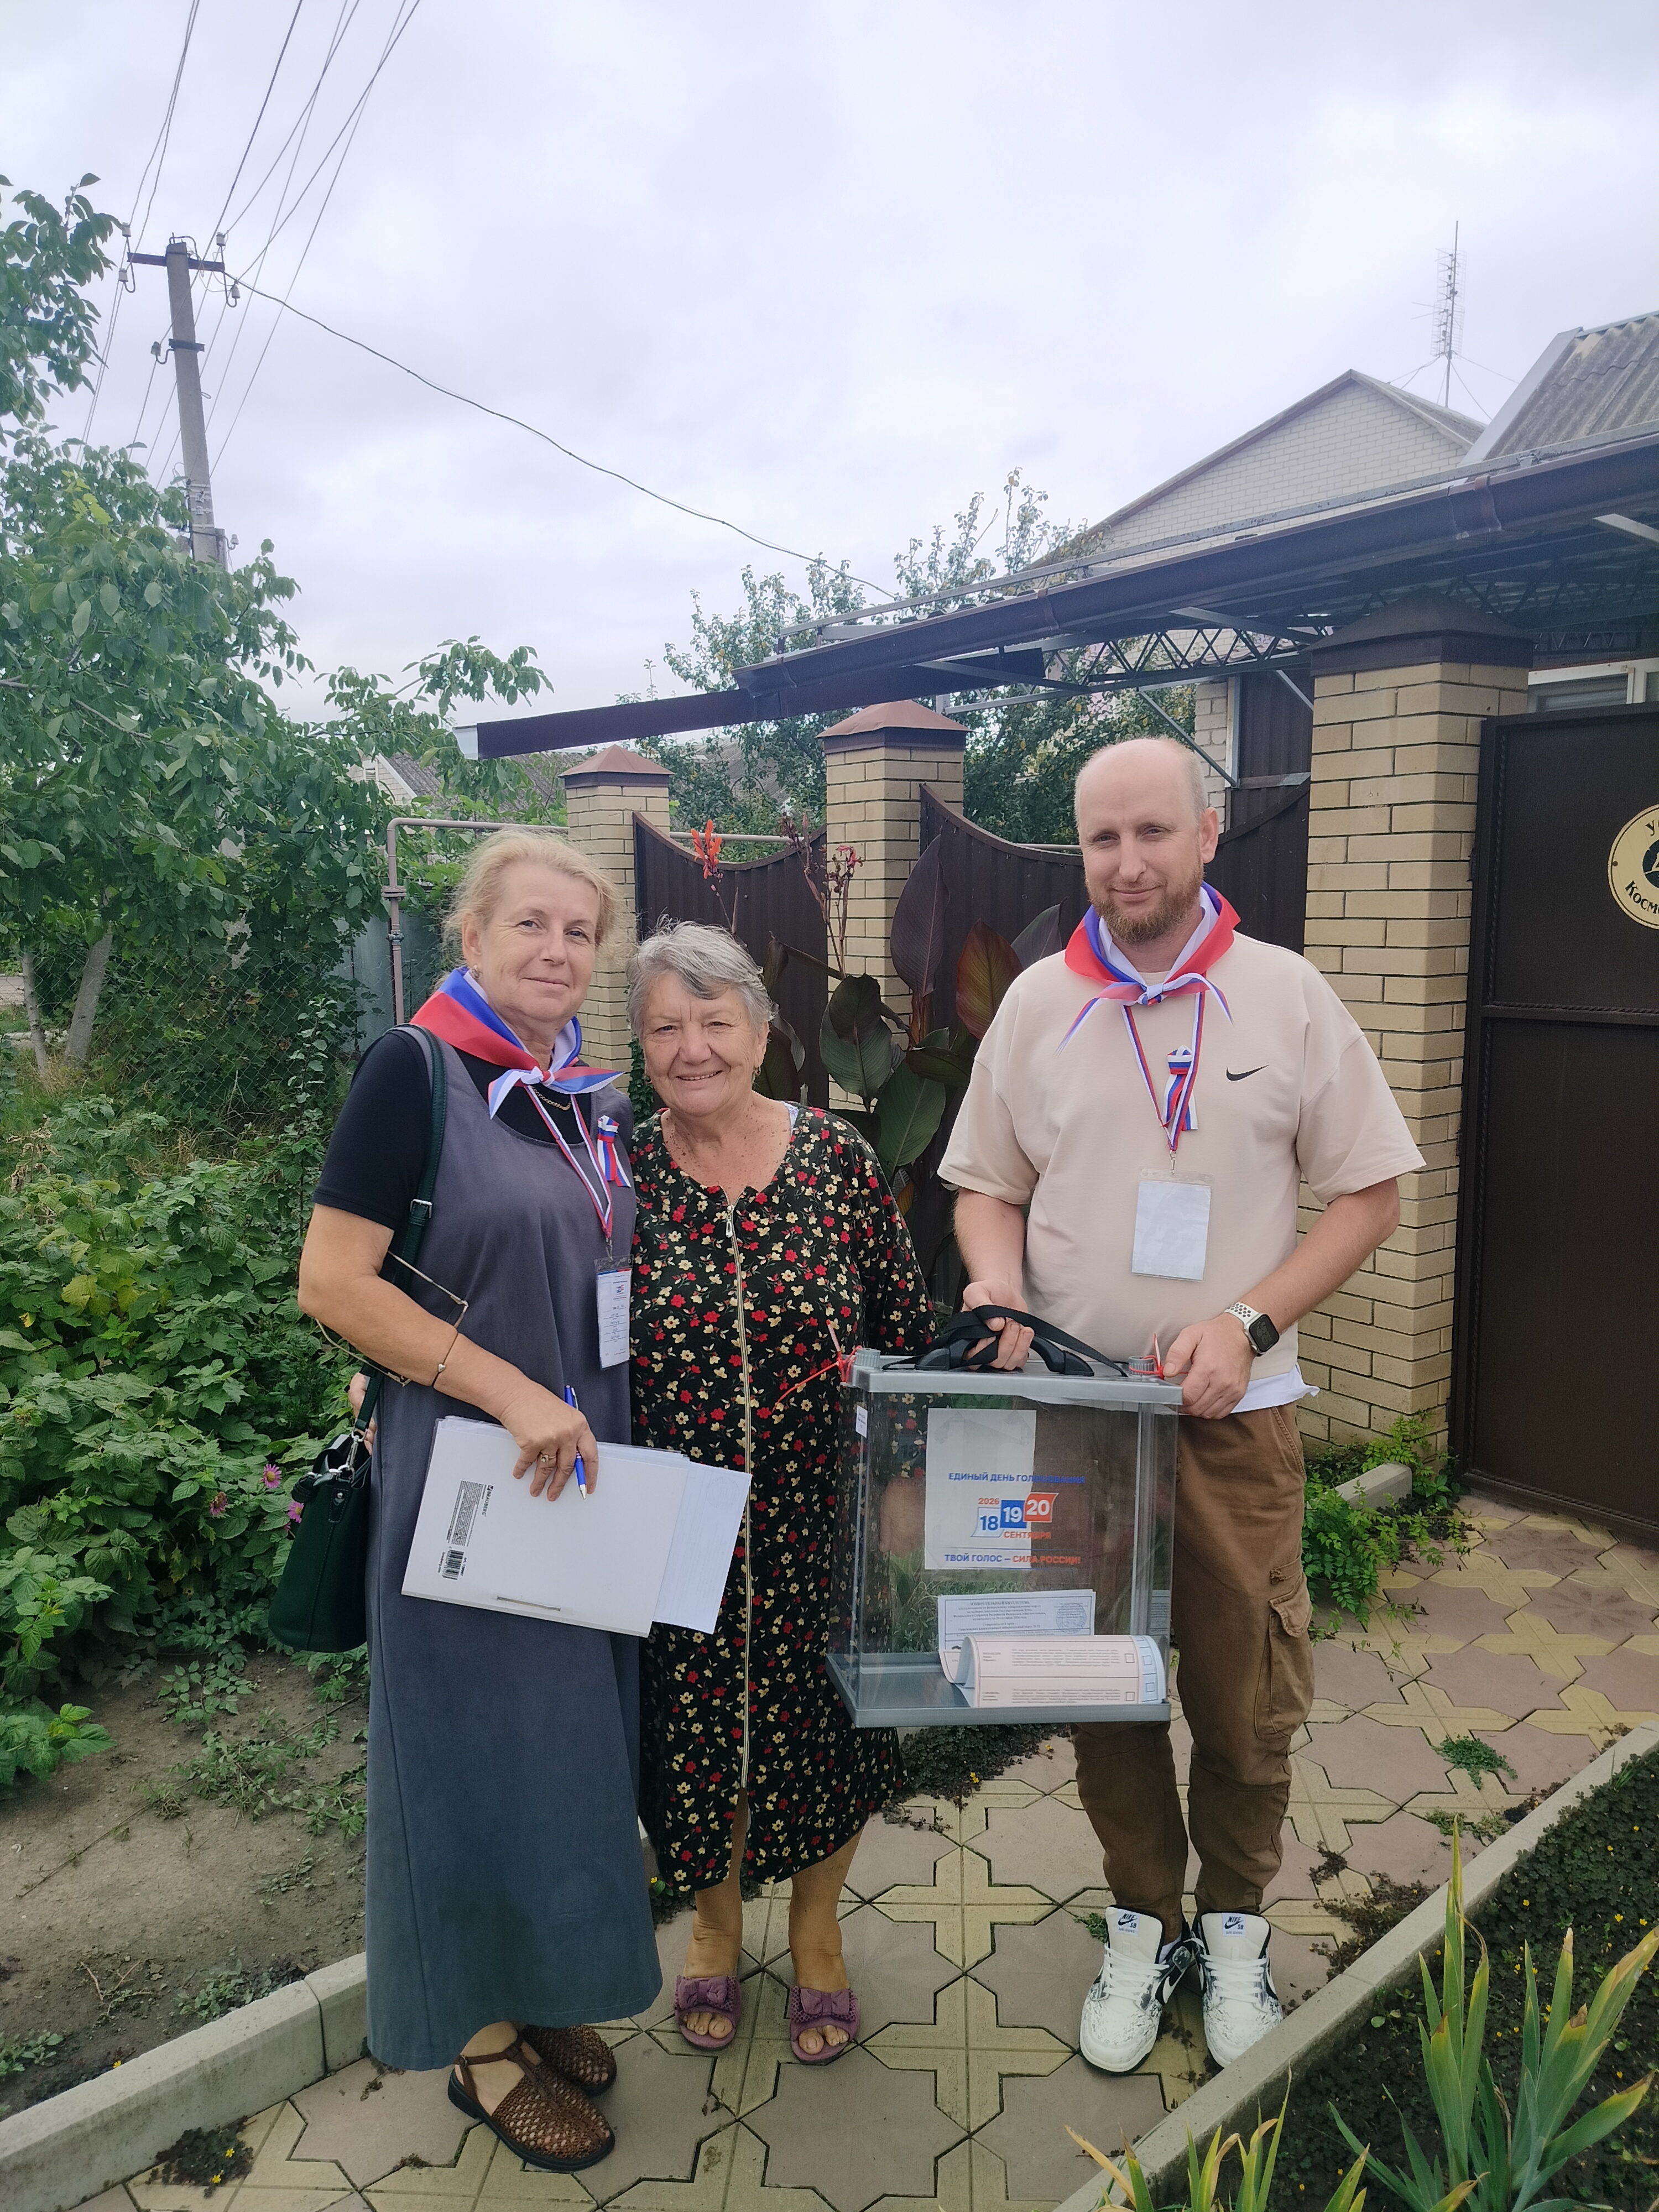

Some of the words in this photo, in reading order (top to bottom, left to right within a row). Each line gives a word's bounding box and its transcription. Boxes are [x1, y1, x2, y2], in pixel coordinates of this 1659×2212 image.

[1645, 820, 1659, 837] у
[1625, 880, 1659, 914] Косм
[948, 1472, 988, 1480] ЕДИНЫЙ
[482, 1491, 492, 1516] BRAUBERG
[980, 1516, 999, 1531] 18
[1003, 1506, 1022, 1523] 19
[1026, 1499, 1050, 1516] 20
[945, 1553, 969, 1562] ТВОЙ
[1039, 1556, 1081, 1564] РОССИИ!
